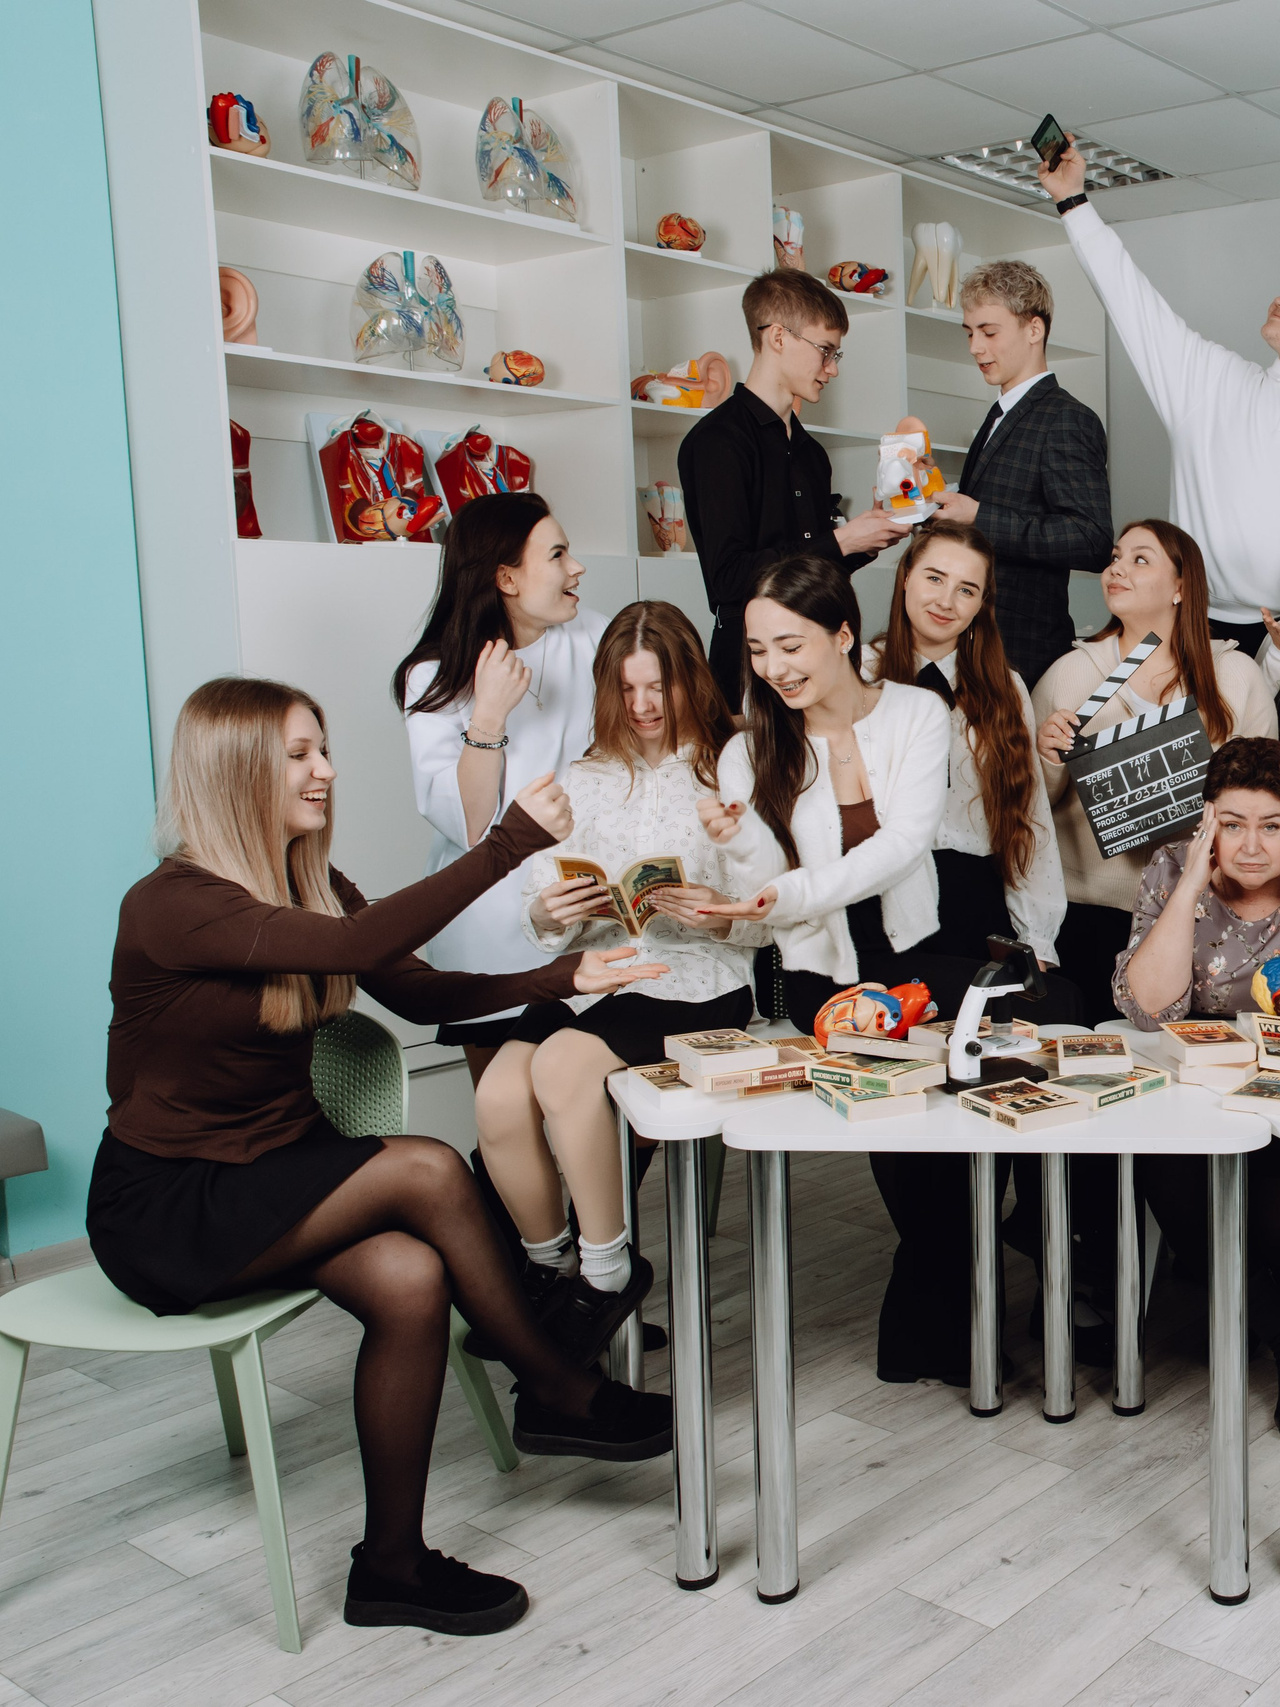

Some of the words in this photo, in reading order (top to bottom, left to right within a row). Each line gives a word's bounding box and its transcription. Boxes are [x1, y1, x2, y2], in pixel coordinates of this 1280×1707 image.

[1172, 737, 1194, 751] ROLL
[1129, 754, 1151, 768] TAKE
[1086, 769, 1113, 786] SCENE
[1169, 769, 1199, 786] SOUND
[1092, 781, 1114, 802] 67
[1091, 806, 1108, 816] DATE
[1101, 823, 1135, 842] DIRECTOR
[1107, 835, 1149, 856] CAMERAMAN
[1171, 1025, 1230, 1033] РЕМАРК
[996, 1112, 1016, 1128] ФАУСТ
